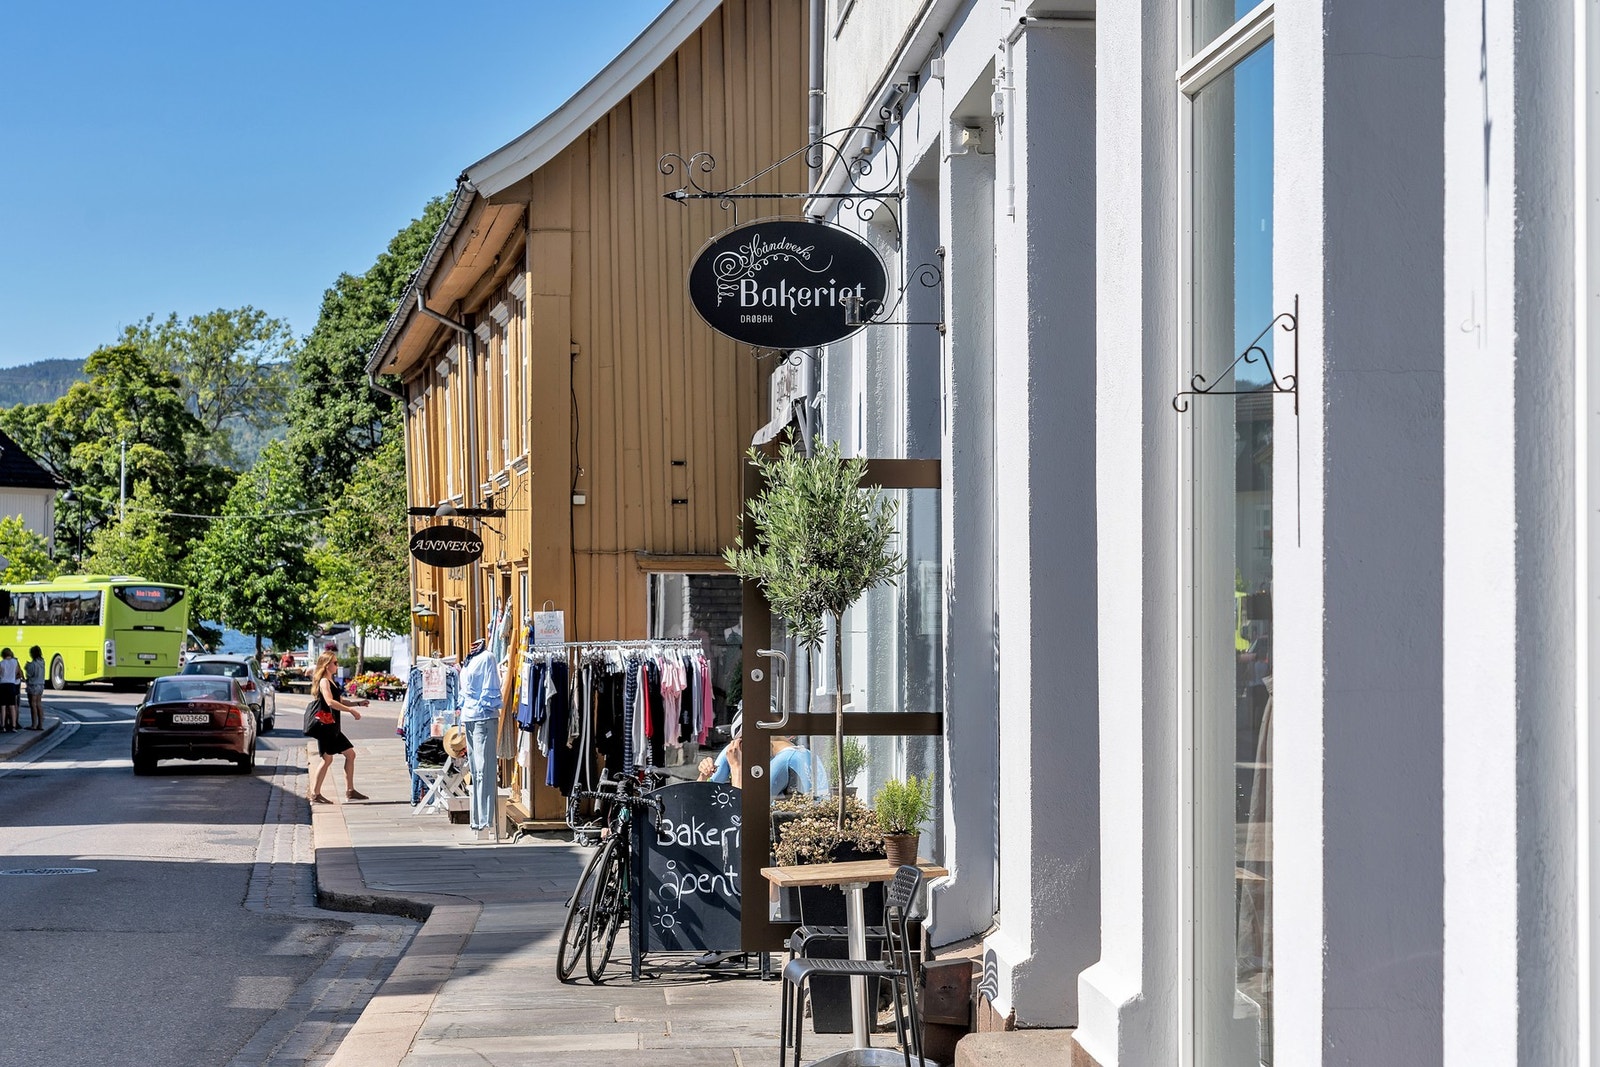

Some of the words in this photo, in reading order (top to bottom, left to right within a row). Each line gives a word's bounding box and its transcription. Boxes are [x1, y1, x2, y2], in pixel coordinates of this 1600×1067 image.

[740, 278, 866, 315] Bakeriet
[740, 314, 774, 324] DRØBAK
[411, 539, 482, 554] ANNEK'S
